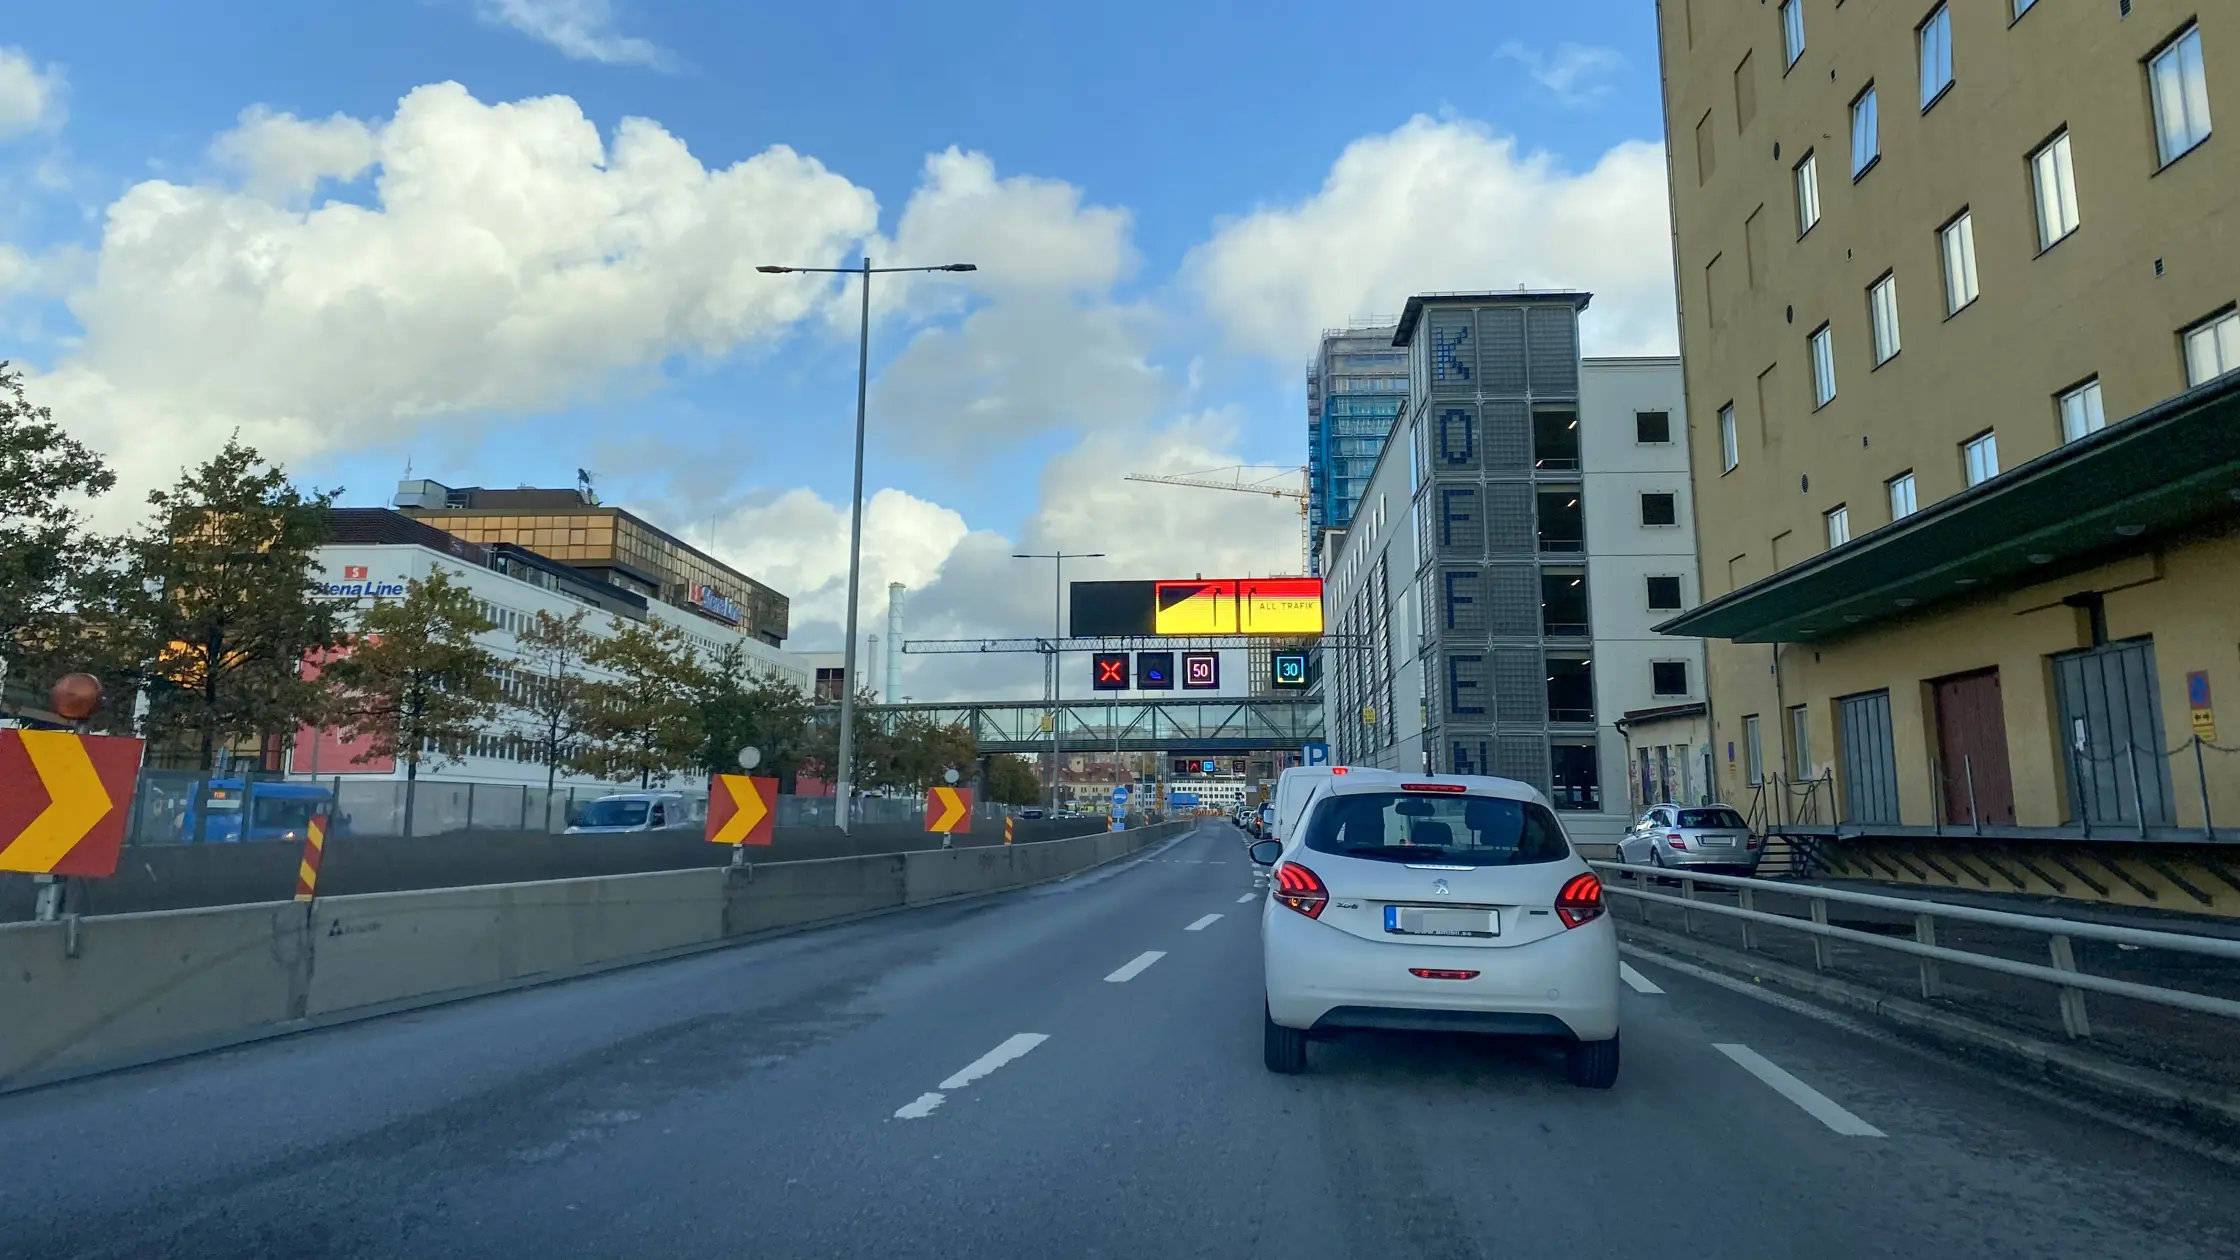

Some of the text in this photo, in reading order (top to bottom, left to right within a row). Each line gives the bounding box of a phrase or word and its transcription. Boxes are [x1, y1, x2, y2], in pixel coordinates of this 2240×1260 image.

[364, 581, 404, 596] Line
[1260, 602, 1314, 610] ALL TRAFIK
[1193, 663, 1208, 677] 50
[1283, 663, 1298, 676] 30
